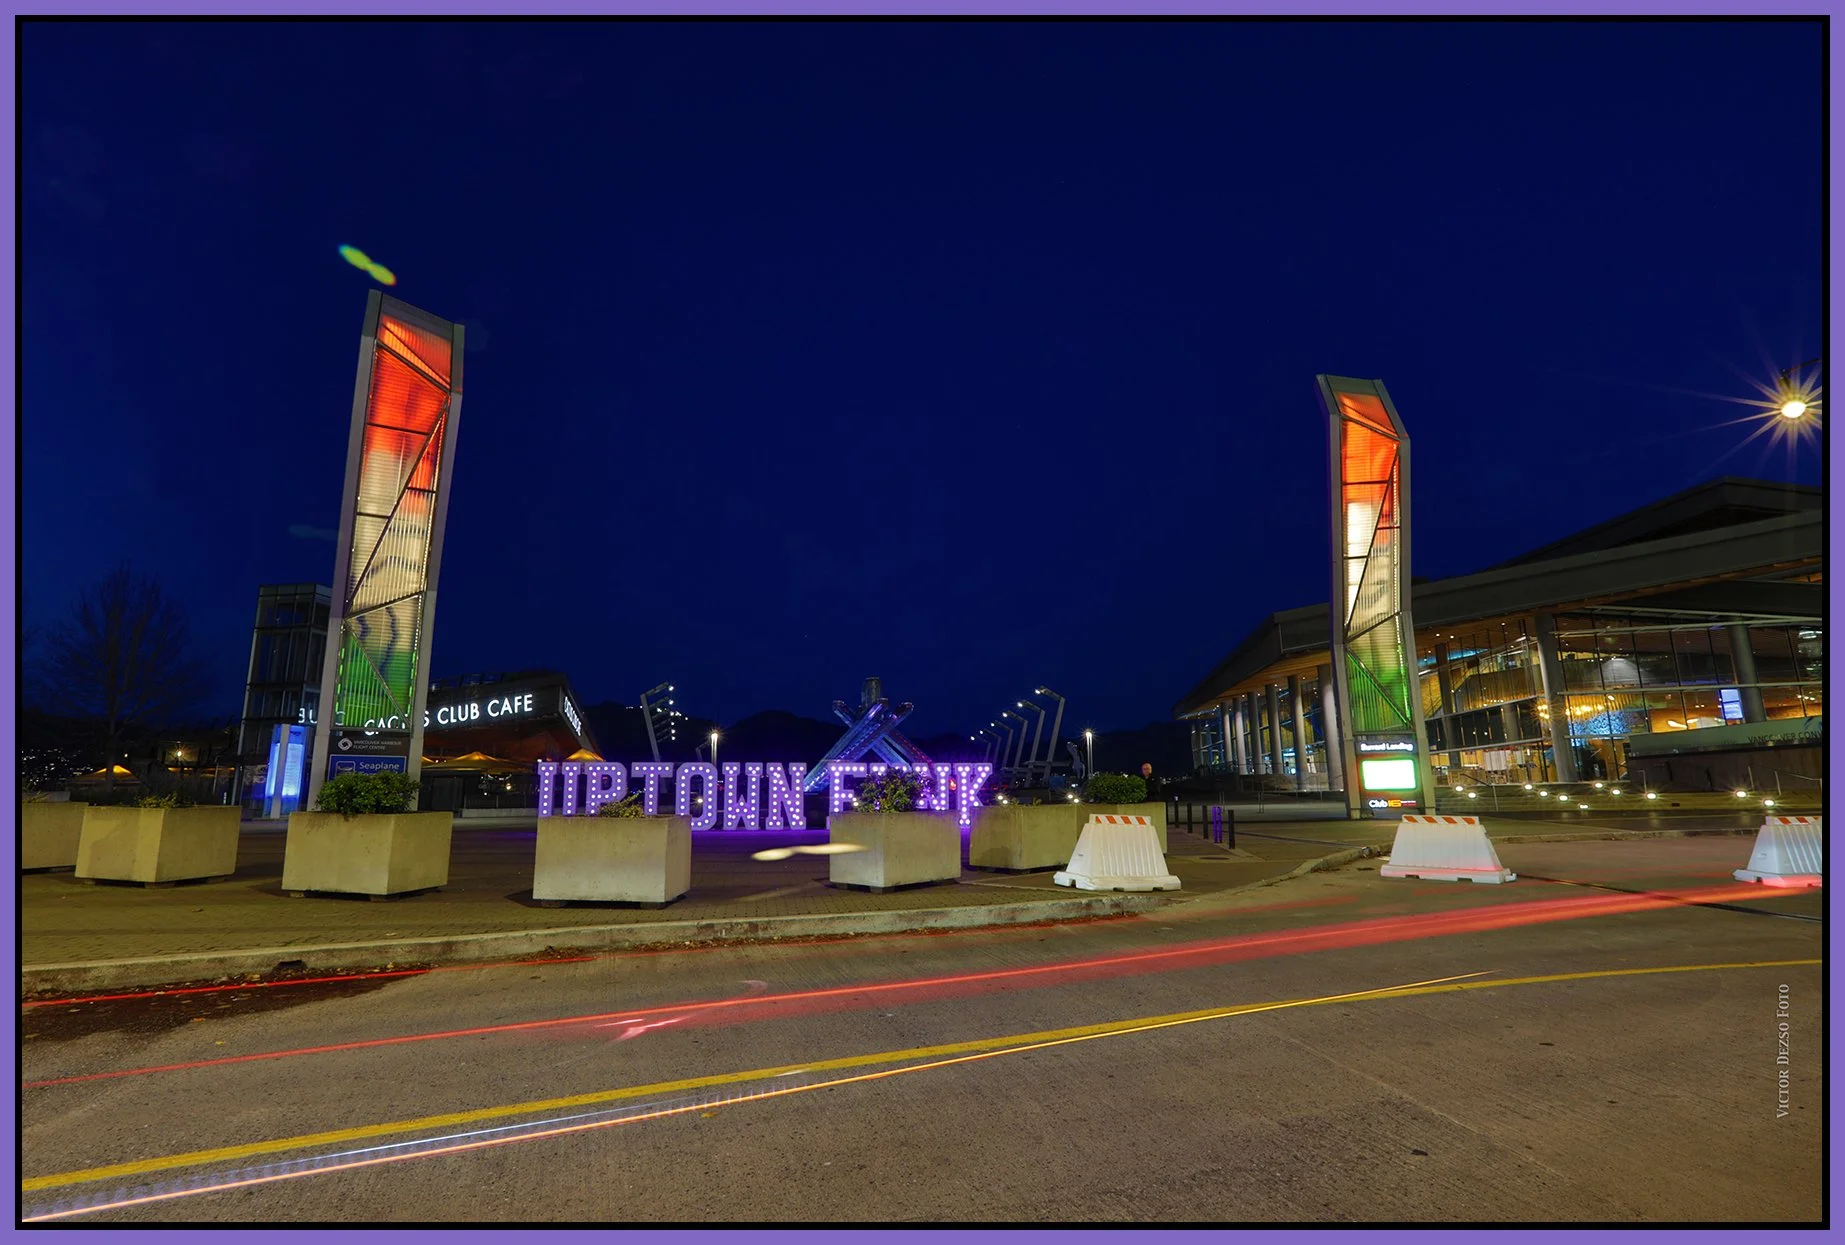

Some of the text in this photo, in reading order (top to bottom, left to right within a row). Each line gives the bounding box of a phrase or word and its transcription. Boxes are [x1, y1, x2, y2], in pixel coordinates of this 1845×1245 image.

[437, 702, 479, 724] CLUB
[487, 694, 533, 717] CAFE
[359, 761, 400, 771] Seaplane
[537, 762, 807, 830] UPTOWN
[1369, 800, 1388, 808] Club
